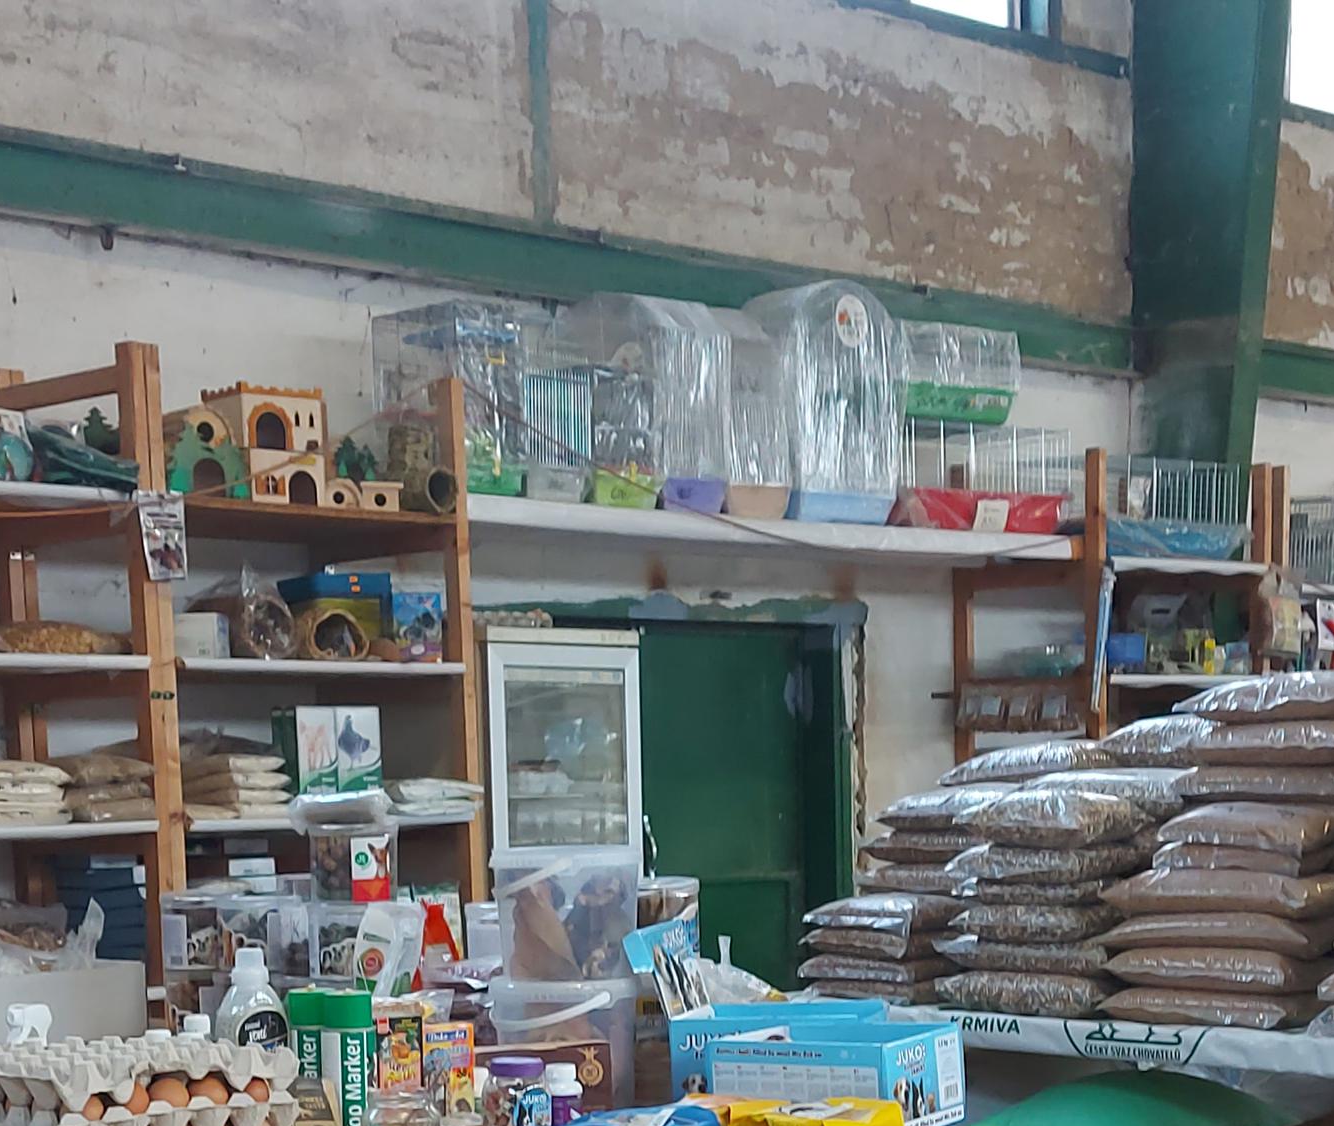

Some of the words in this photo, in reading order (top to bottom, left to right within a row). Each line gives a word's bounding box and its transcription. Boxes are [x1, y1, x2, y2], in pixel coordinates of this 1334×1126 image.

[951, 1015, 1020, 1034] KRMIVA
[304, 1035, 316, 1079] arker
[343, 1036, 361, 1100] Marker
[1110, 1045, 1132, 1058] SVAZ
[1133, 1046, 1181, 1061] CHOVATELŮ
